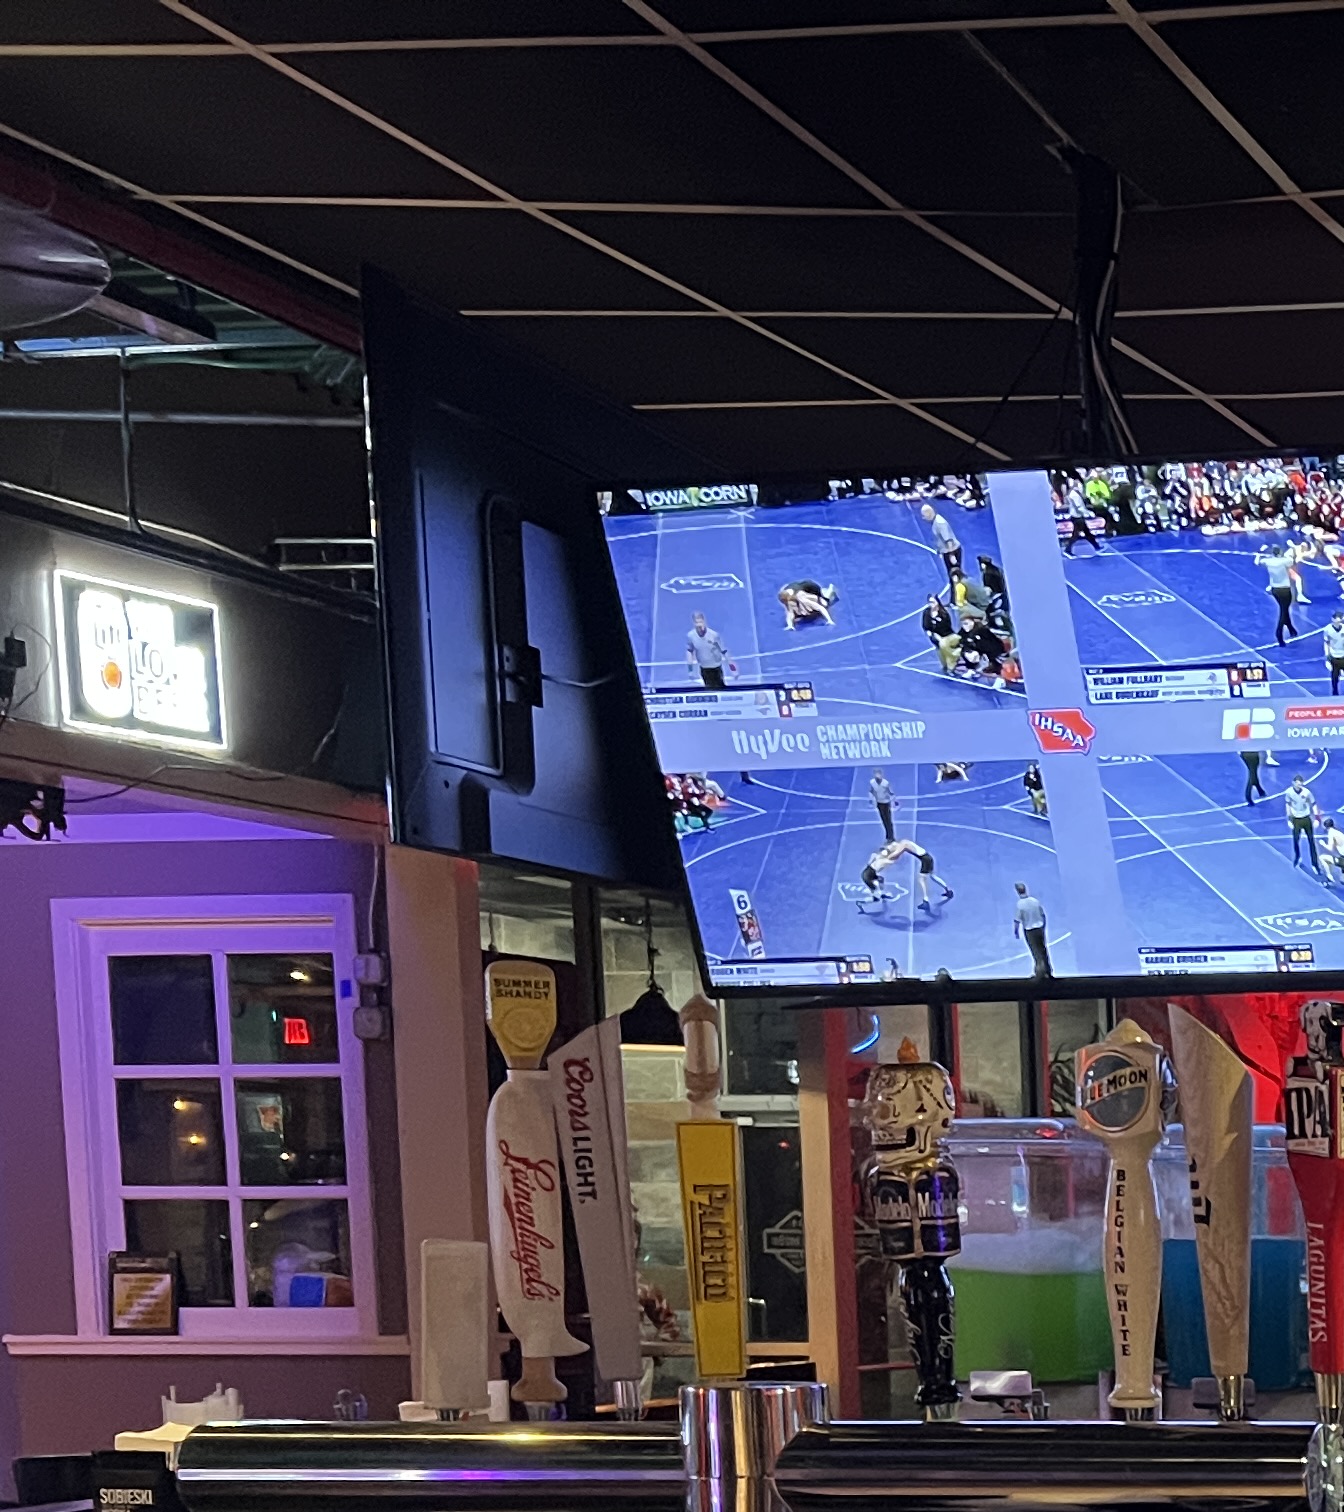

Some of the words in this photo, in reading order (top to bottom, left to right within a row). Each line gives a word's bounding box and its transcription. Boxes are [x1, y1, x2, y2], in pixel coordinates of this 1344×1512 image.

[645, 489, 690, 507] IOWA
[699, 485, 748, 503] CORN
[816, 721, 926, 742] CHAMPIONSHIP
[1034, 713, 1084, 747] IHSAA
[1287, 727, 1319, 739] IOWA
[819, 740, 892, 760] NETWORK
[493, 978, 551, 989] SUMMER
[495, 988, 550, 1000] SHANDY
[1106, 1068, 1149, 1094] MOON
[572, 1135, 598, 1202] LIGHT
[1114, 1168, 1128, 1275] BELGIAN
[1305, 1220, 1328, 1343] LAGUNITAS
[1114, 1283, 1132, 1358] WHITE
[100, 1488, 153, 1505] SOBIESKI
